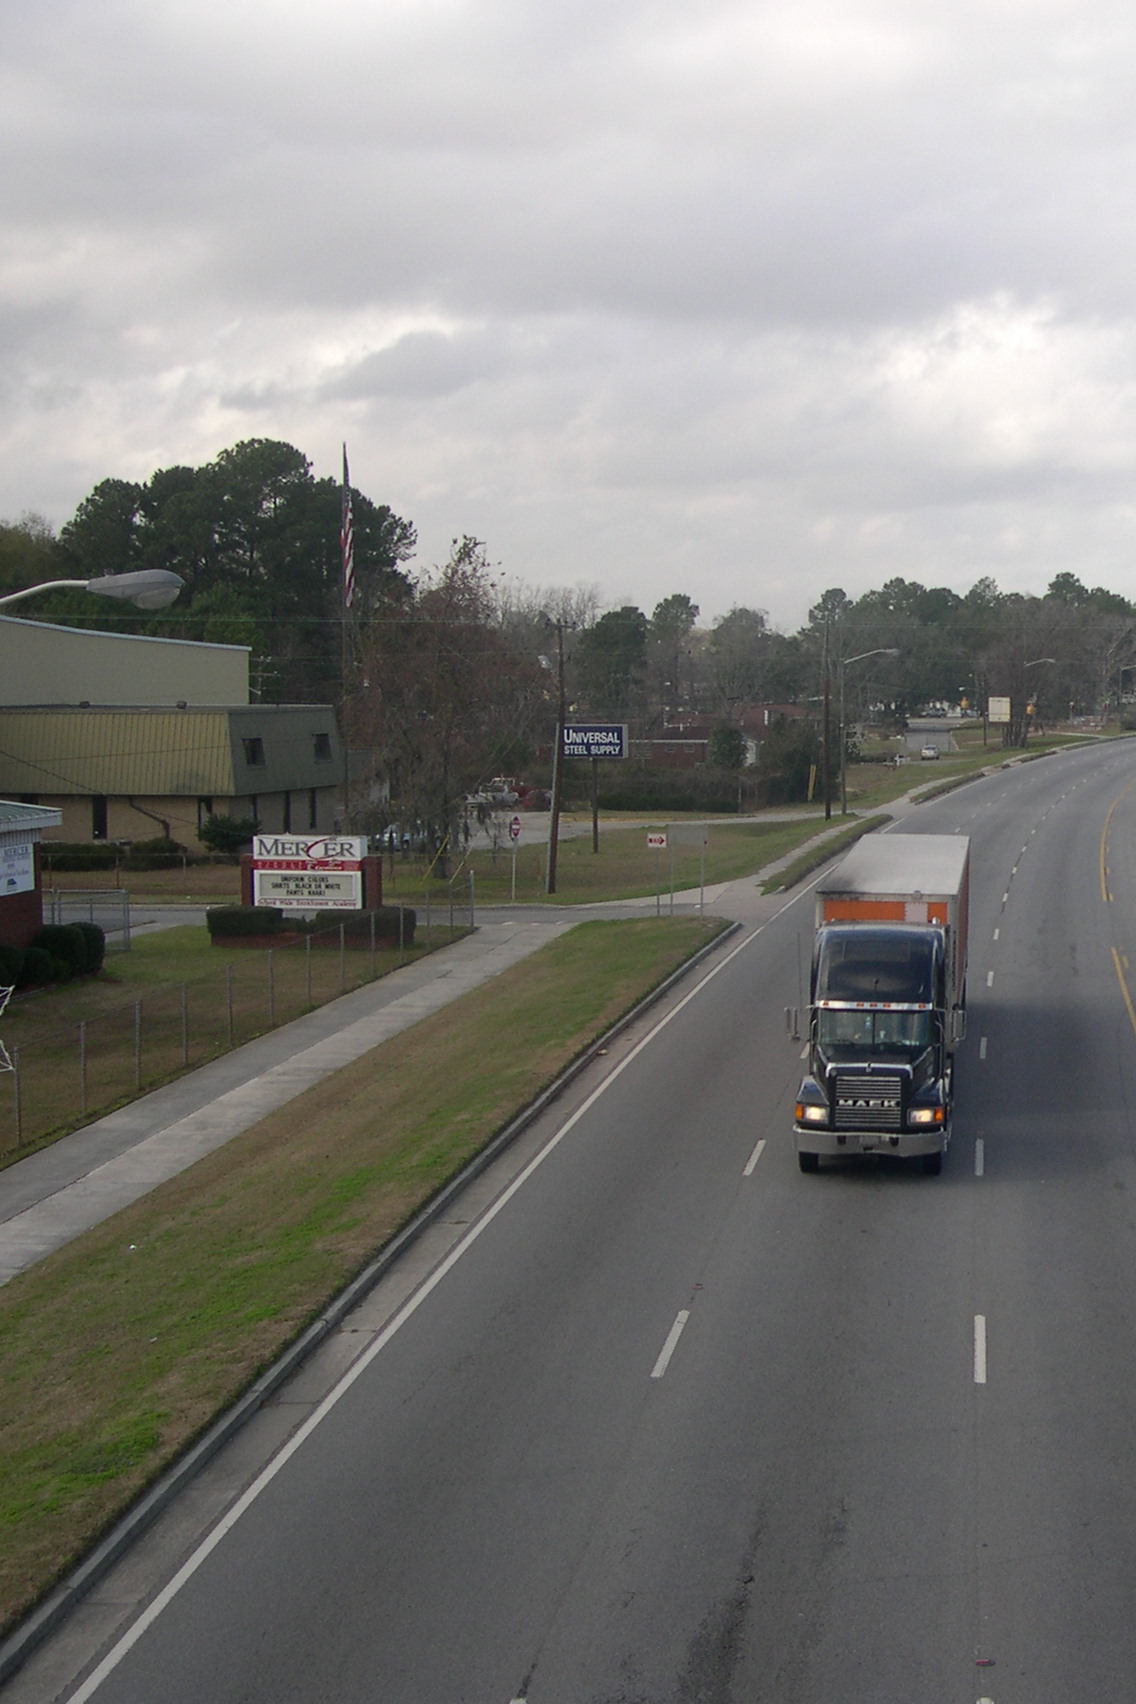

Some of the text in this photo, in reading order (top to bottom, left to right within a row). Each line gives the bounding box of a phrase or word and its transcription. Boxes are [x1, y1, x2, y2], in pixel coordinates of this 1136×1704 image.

[564, 729, 620, 743] UNIVERSAL
[564, 745, 620, 754] STEEL SUPPLY
[258, 836, 356, 859] MERCER
[839, 1099, 897, 1107] MACK
